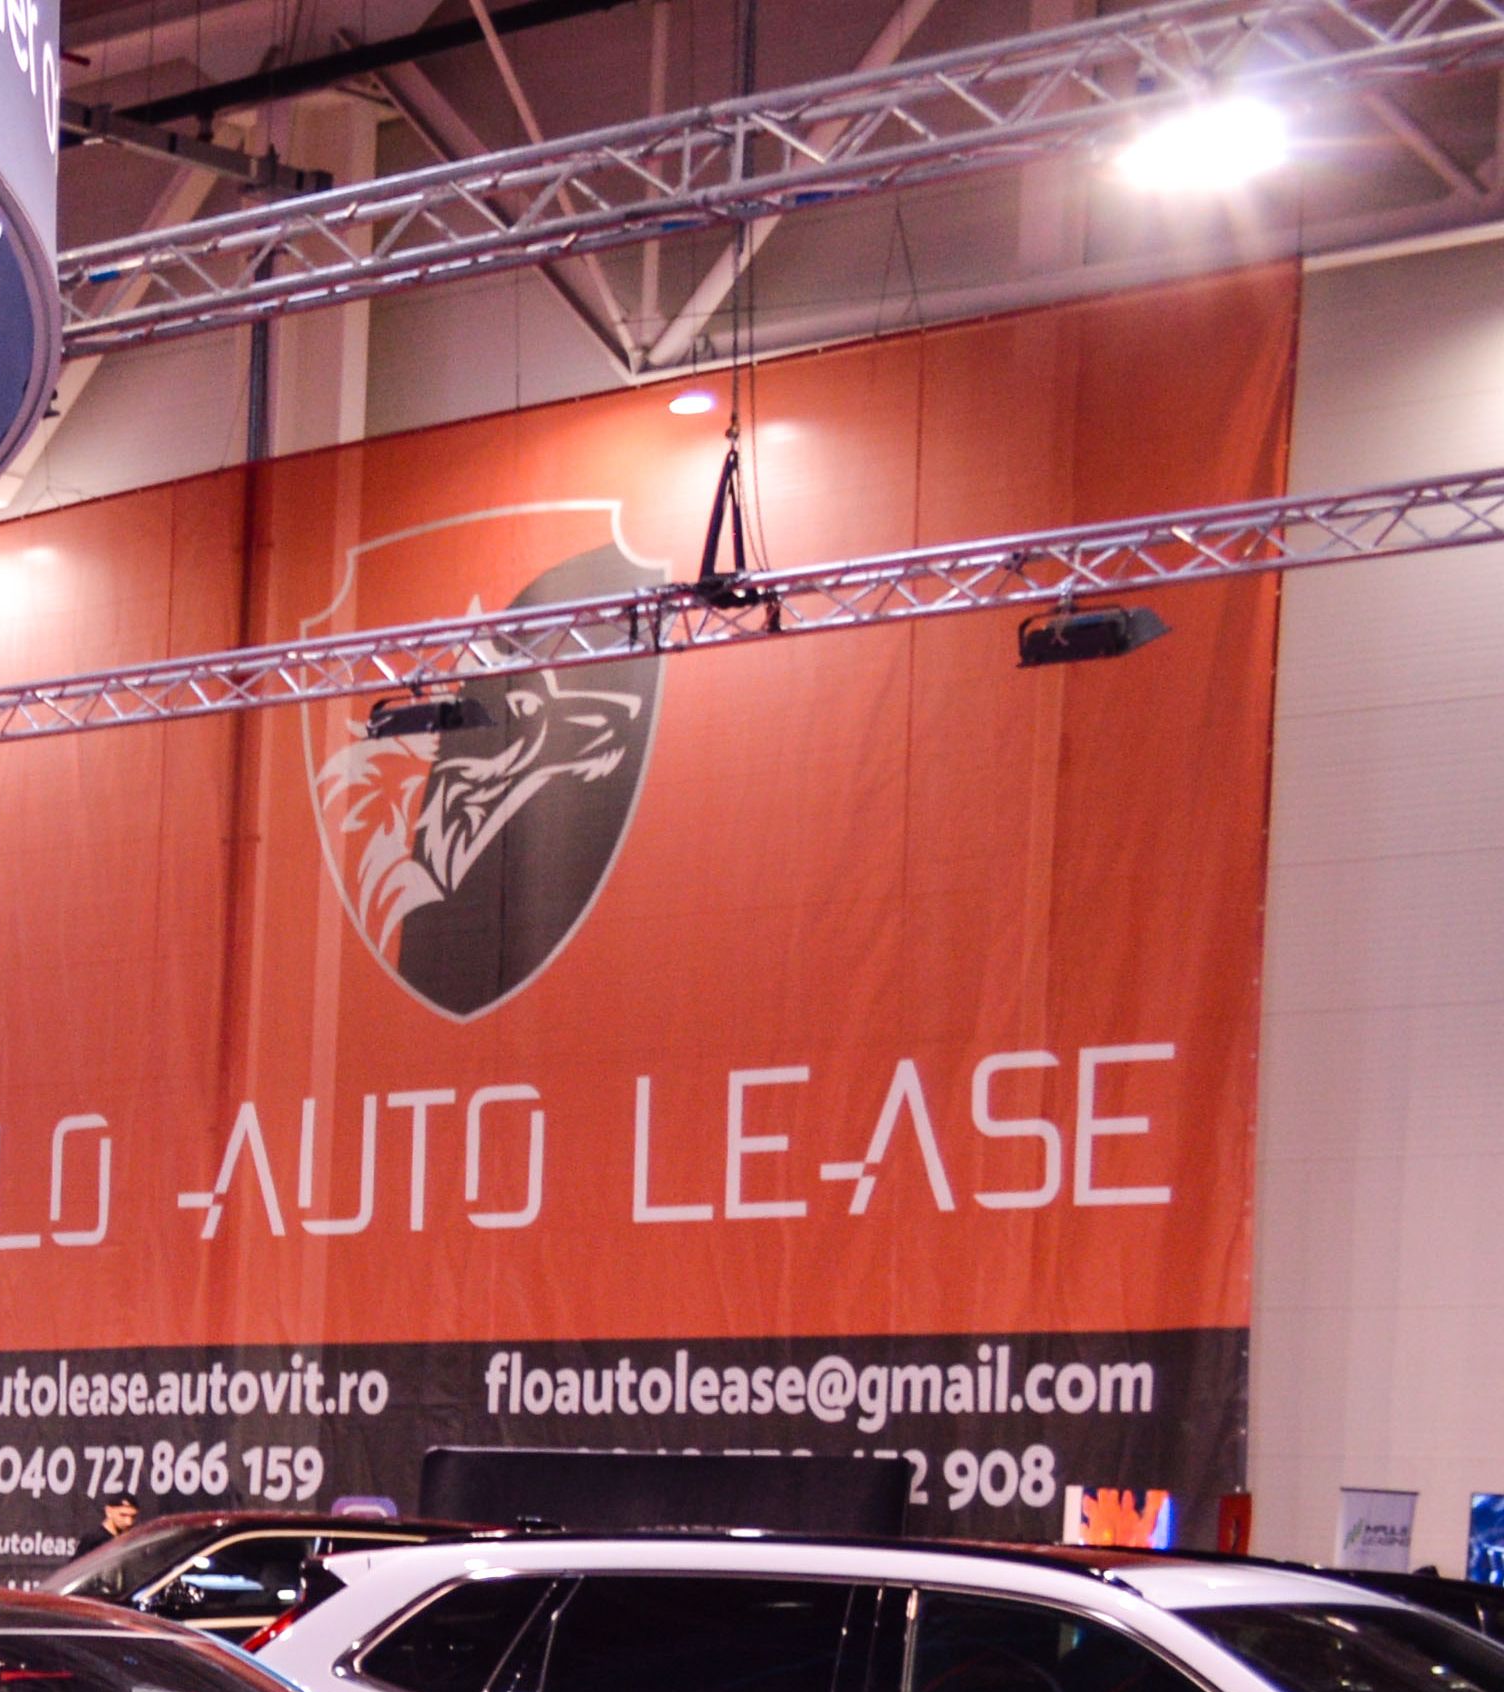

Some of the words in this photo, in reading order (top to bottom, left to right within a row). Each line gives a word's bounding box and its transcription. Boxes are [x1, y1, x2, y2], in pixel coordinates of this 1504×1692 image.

[177, 1084, 547, 1240] AUTO
[632, 1042, 1176, 1224] LEASE
[485, 1343, 1154, 1434] floautolease@gmail.com
[84, 1445, 145, 1500] 727
[150, 1440, 229, 1496] 866
[242, 1446, 324, 1501] 159
[944, 1445, 1057, 1511] 908
